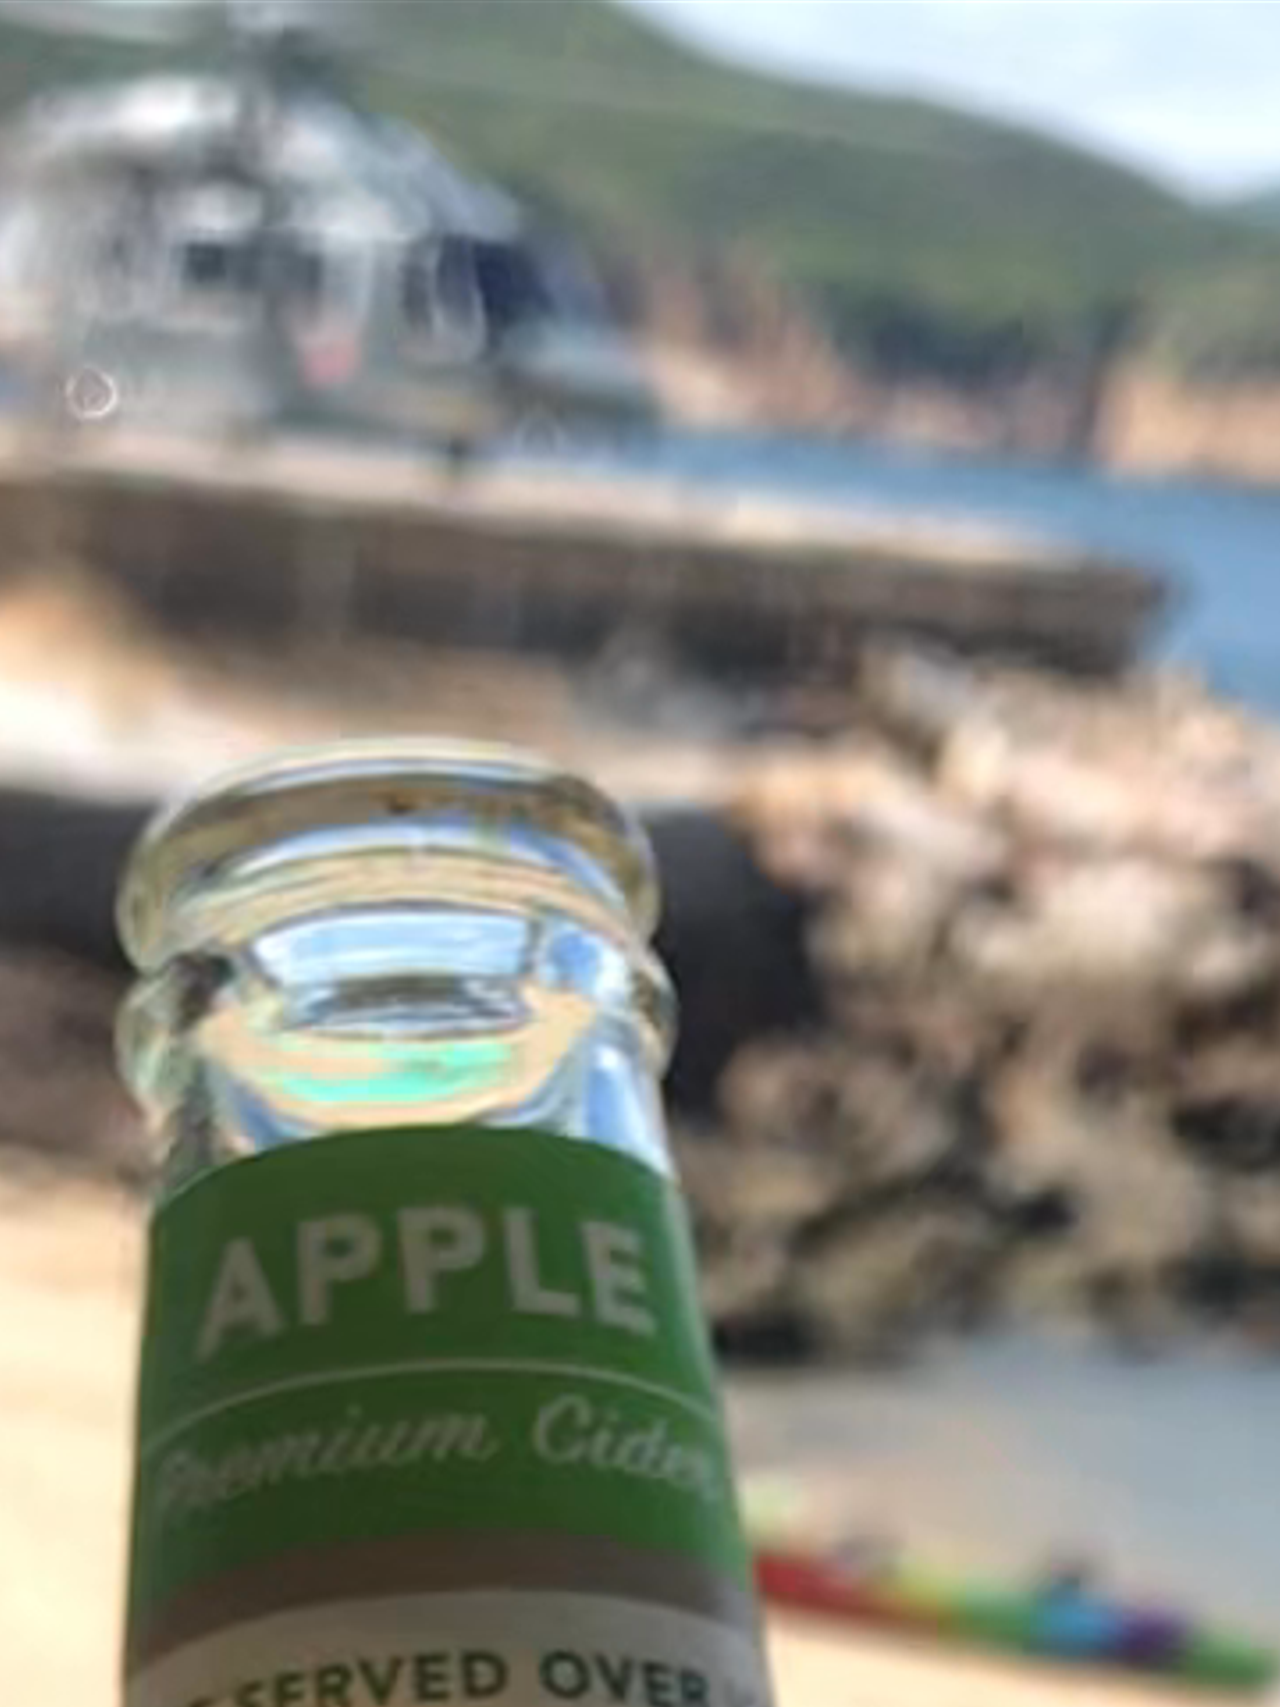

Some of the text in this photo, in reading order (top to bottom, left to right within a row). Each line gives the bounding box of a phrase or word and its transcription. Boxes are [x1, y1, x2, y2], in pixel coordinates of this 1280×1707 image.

[195, 1204, 658, 1362] APPLE
[156, 1393, 716, 1512] Premium Cider
